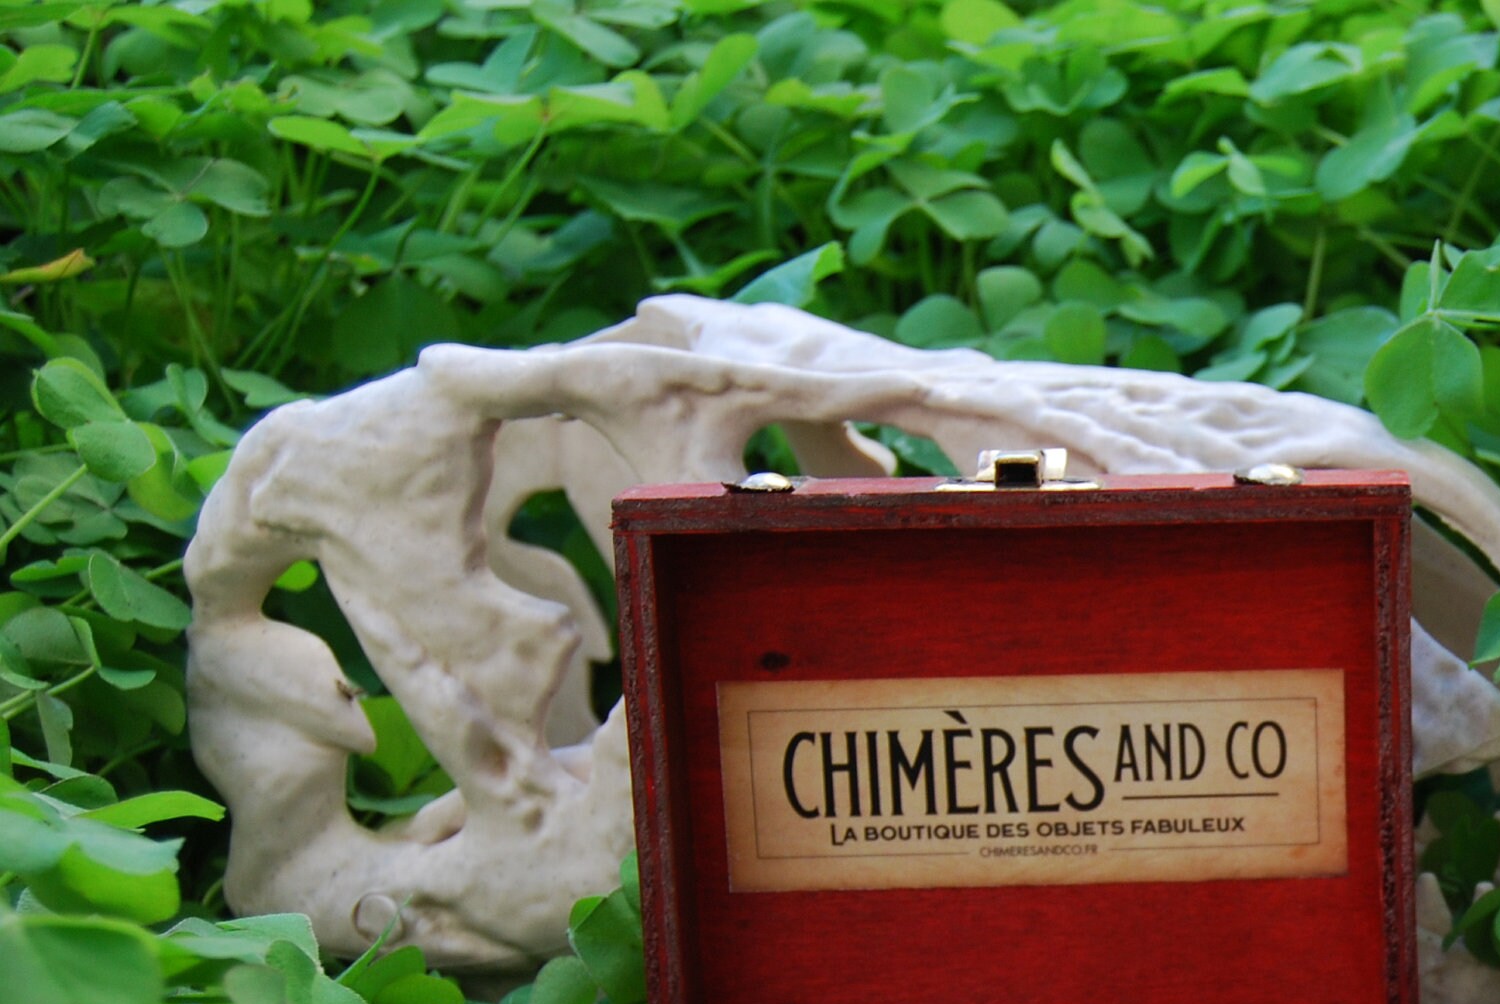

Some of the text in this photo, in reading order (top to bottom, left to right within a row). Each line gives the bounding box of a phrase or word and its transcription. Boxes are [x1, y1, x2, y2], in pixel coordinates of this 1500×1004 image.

[782, 710, 1288, 819] CHIMÈRES AND CO
[865, 824, 981, 842] BOUTIQUE
[986, 822, 1030, 839] DES
[1036, 820, 1125, 838] OBJETS
[1130, 816, 1246, 835] FABULEUX
